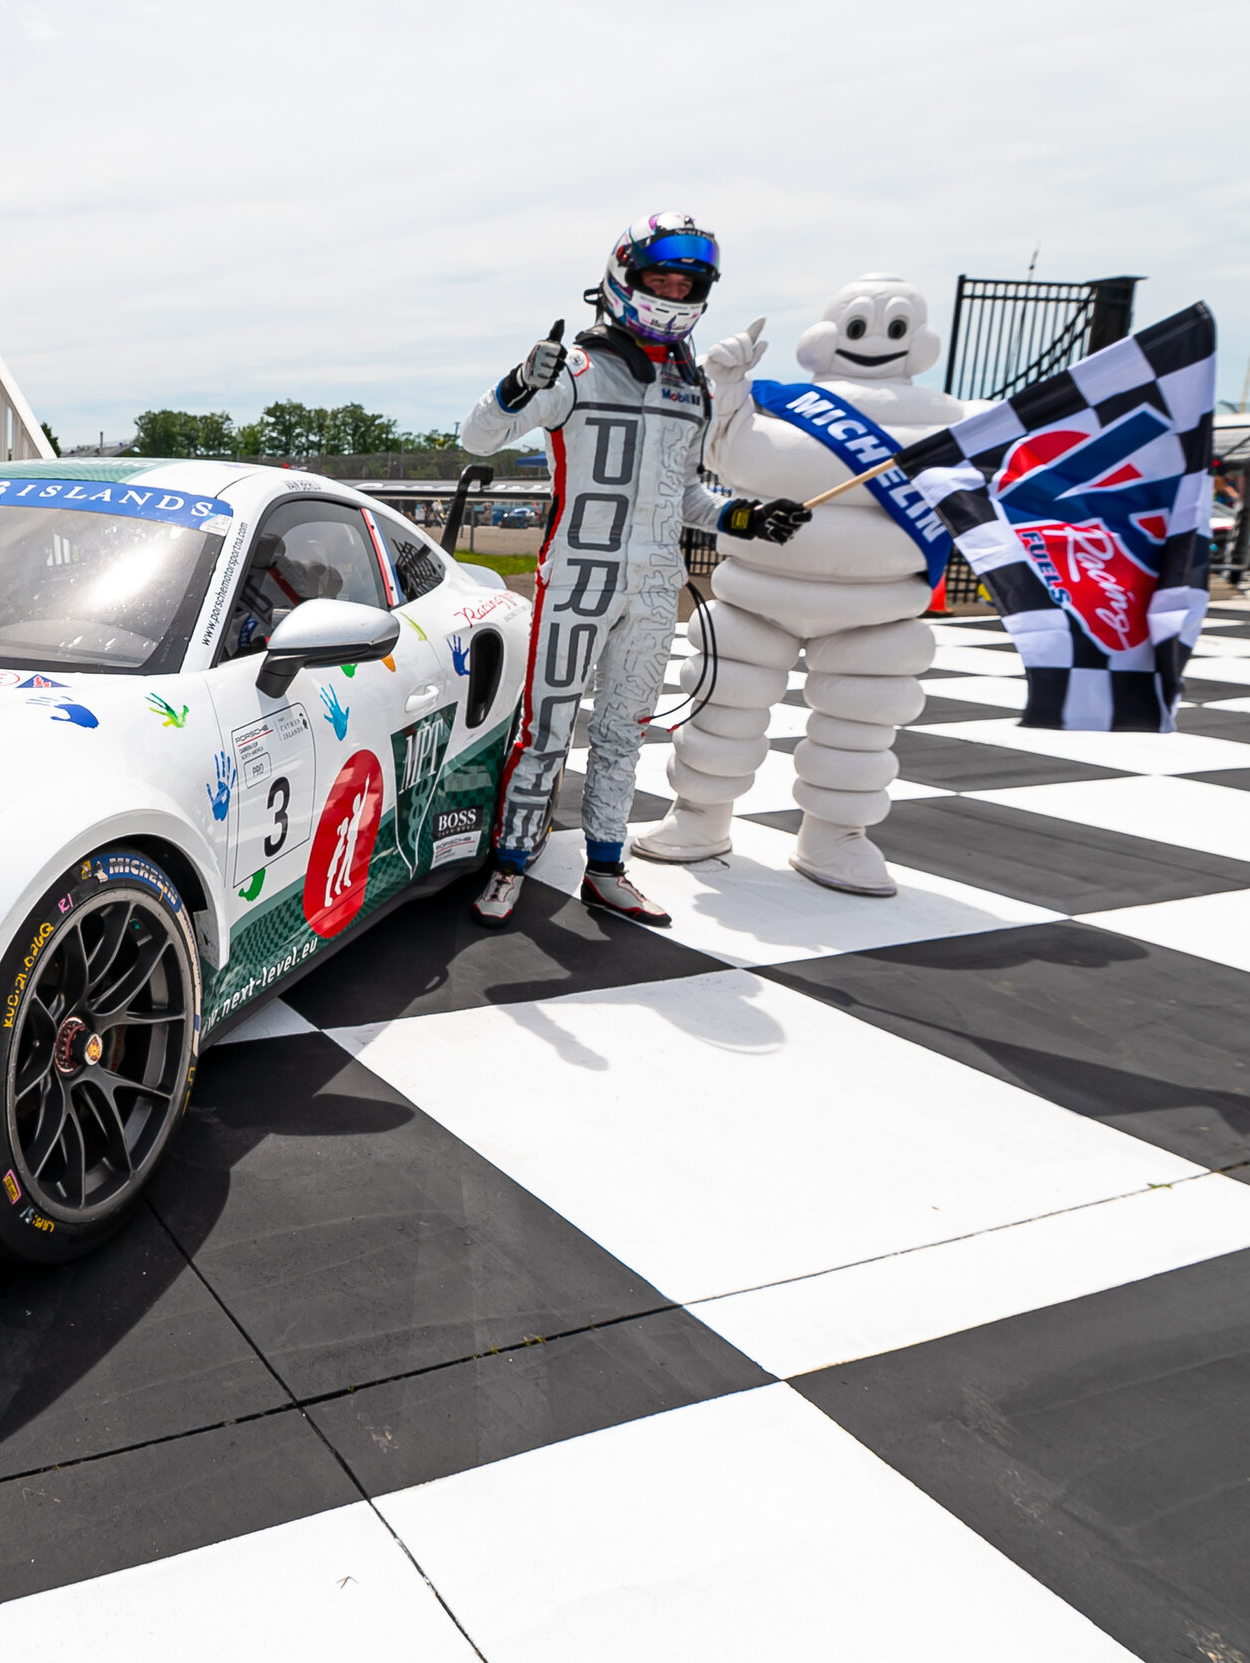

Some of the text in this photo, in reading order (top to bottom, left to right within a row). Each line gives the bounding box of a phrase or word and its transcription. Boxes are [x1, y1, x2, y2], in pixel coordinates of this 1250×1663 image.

[16, 485, 214, 517] ISLANDS
[786, 391, 947, 543] MICHELIN
[201, 521, 250, 647] www.porschemotorsportna.com
[1022, 531, 1073, 609] FUELS
[1042, 526, 1136, 649] Racing
[500, 417, 638, 850] PORSCHE
[264, 776, 291, 857] 3
[438, 809, 477, 831] BOSS
[202, 937, 318, 1038] w.next-level.eu
